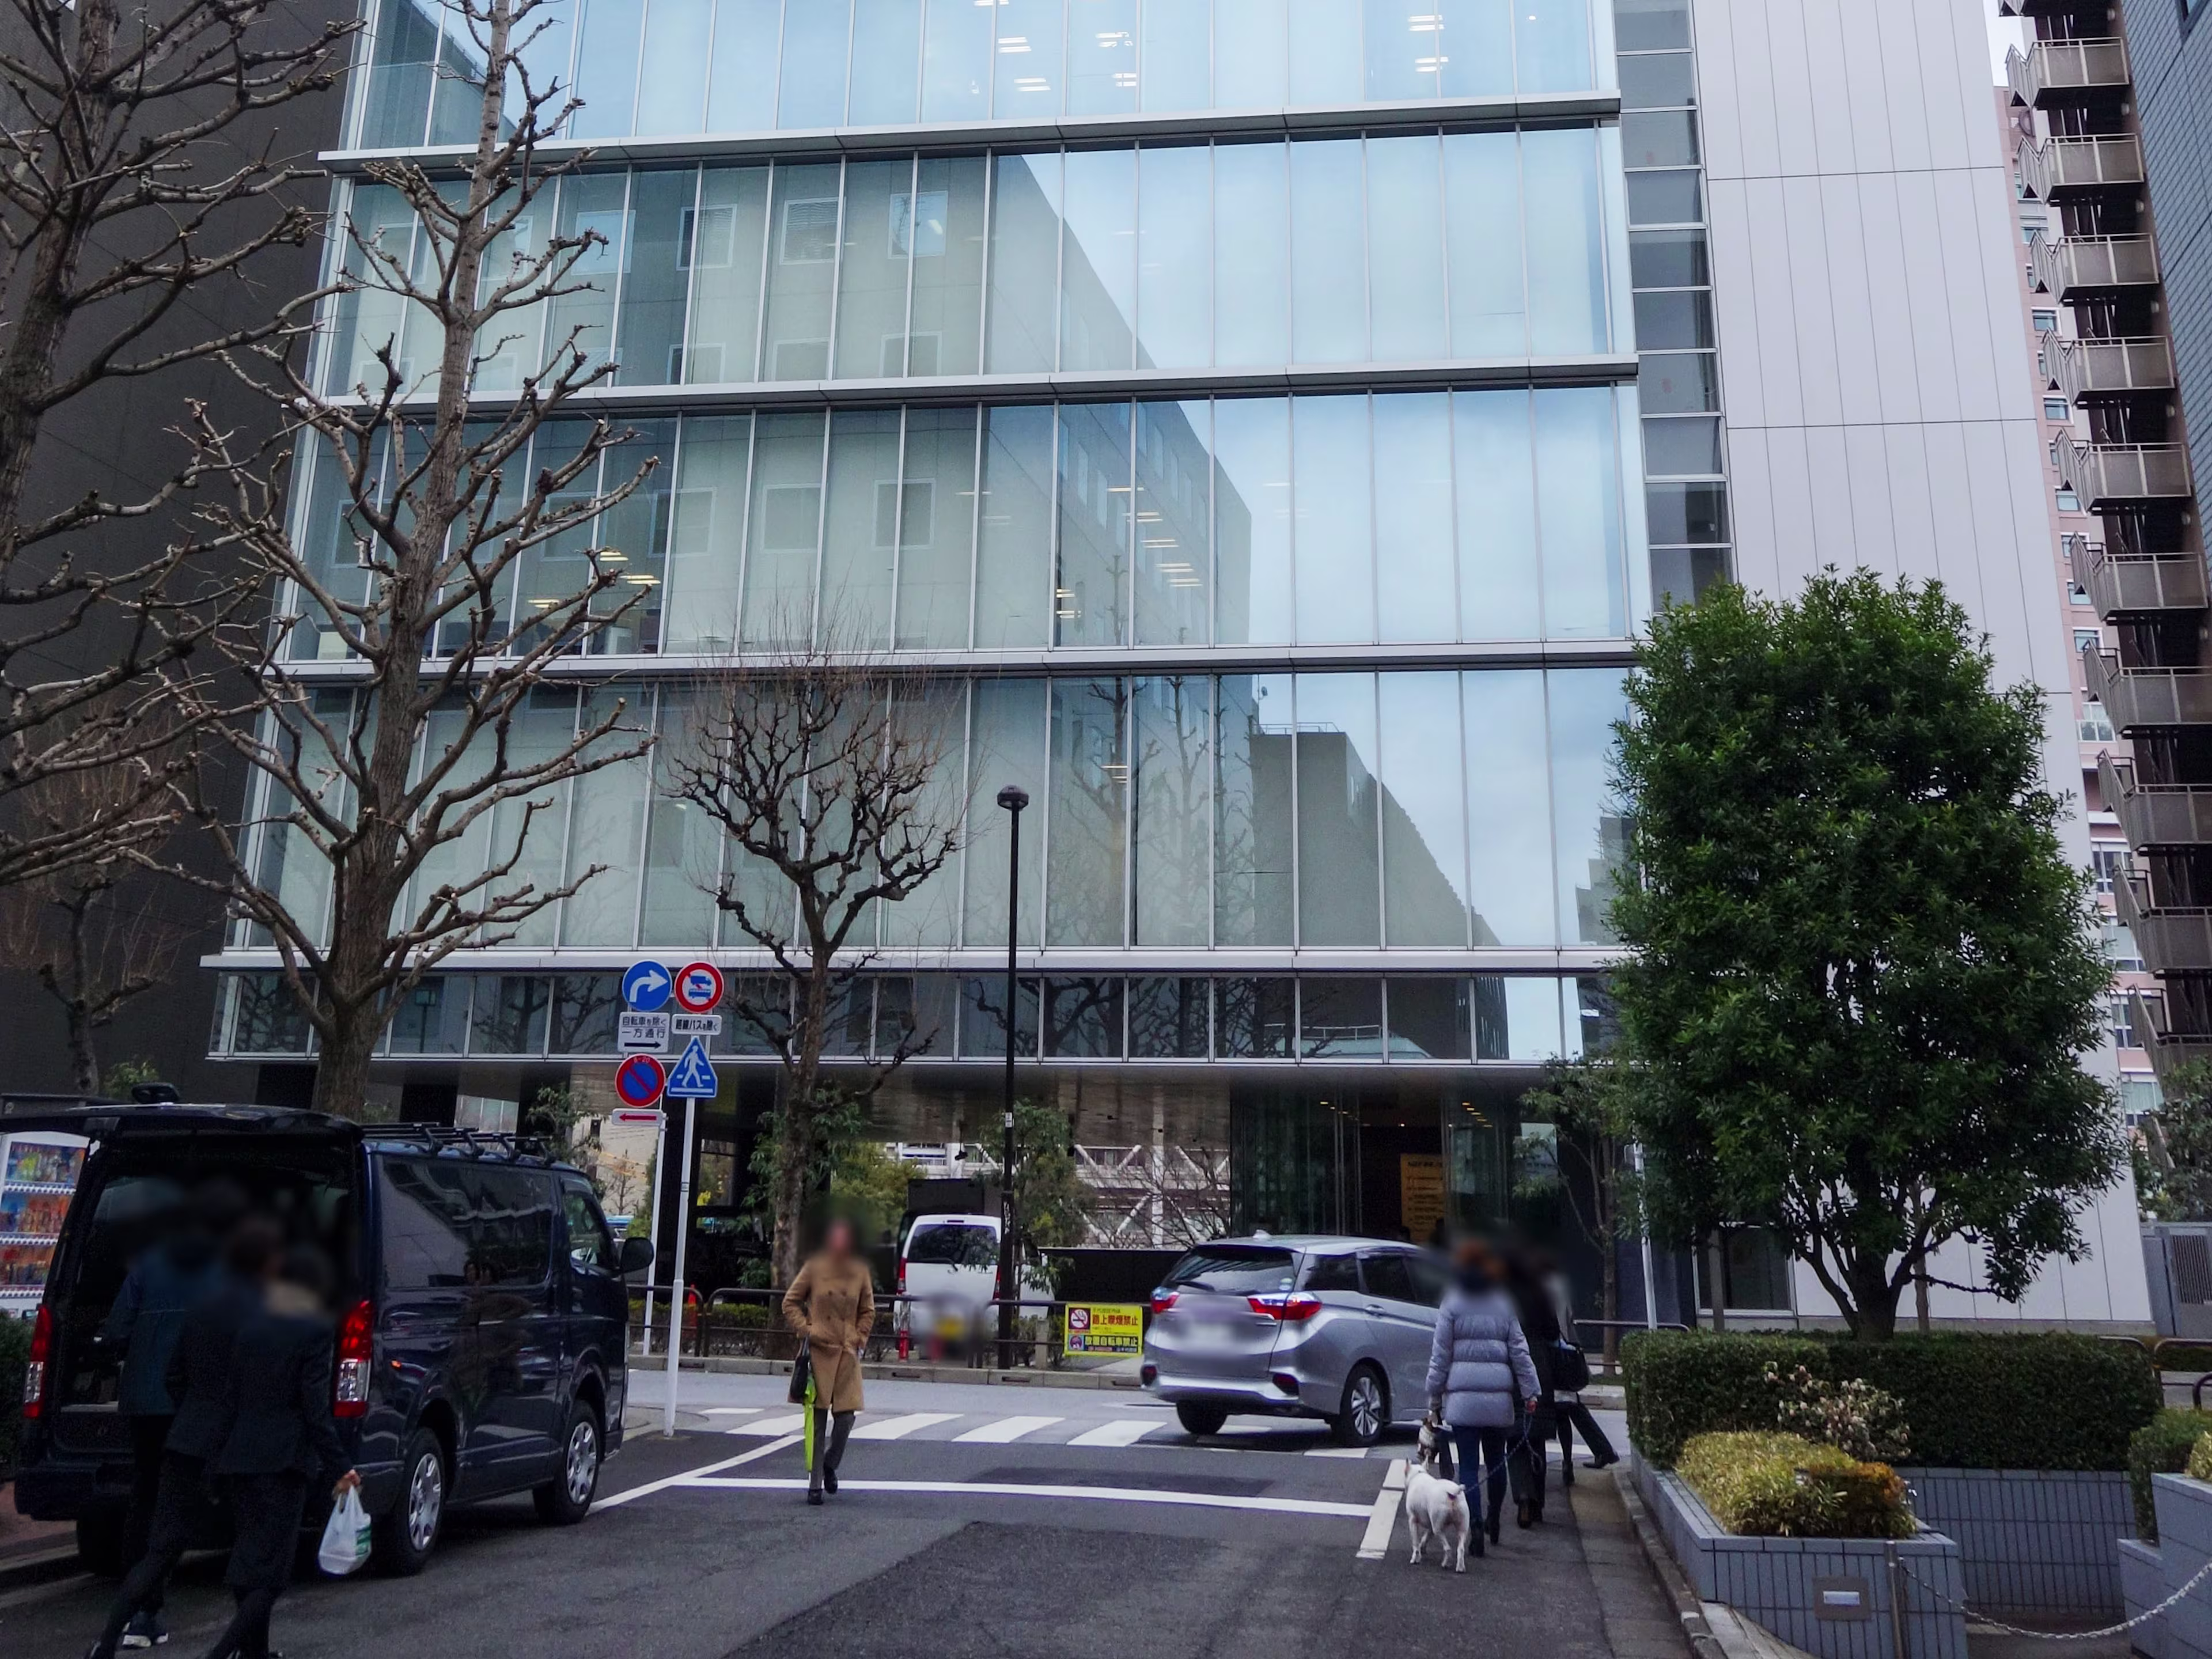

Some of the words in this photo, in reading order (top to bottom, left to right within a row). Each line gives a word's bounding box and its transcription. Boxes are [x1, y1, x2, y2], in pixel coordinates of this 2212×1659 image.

[623, 1016, 666, 1025] 自転車を除く
[622, 1028, 665, 1038] 一方通行
